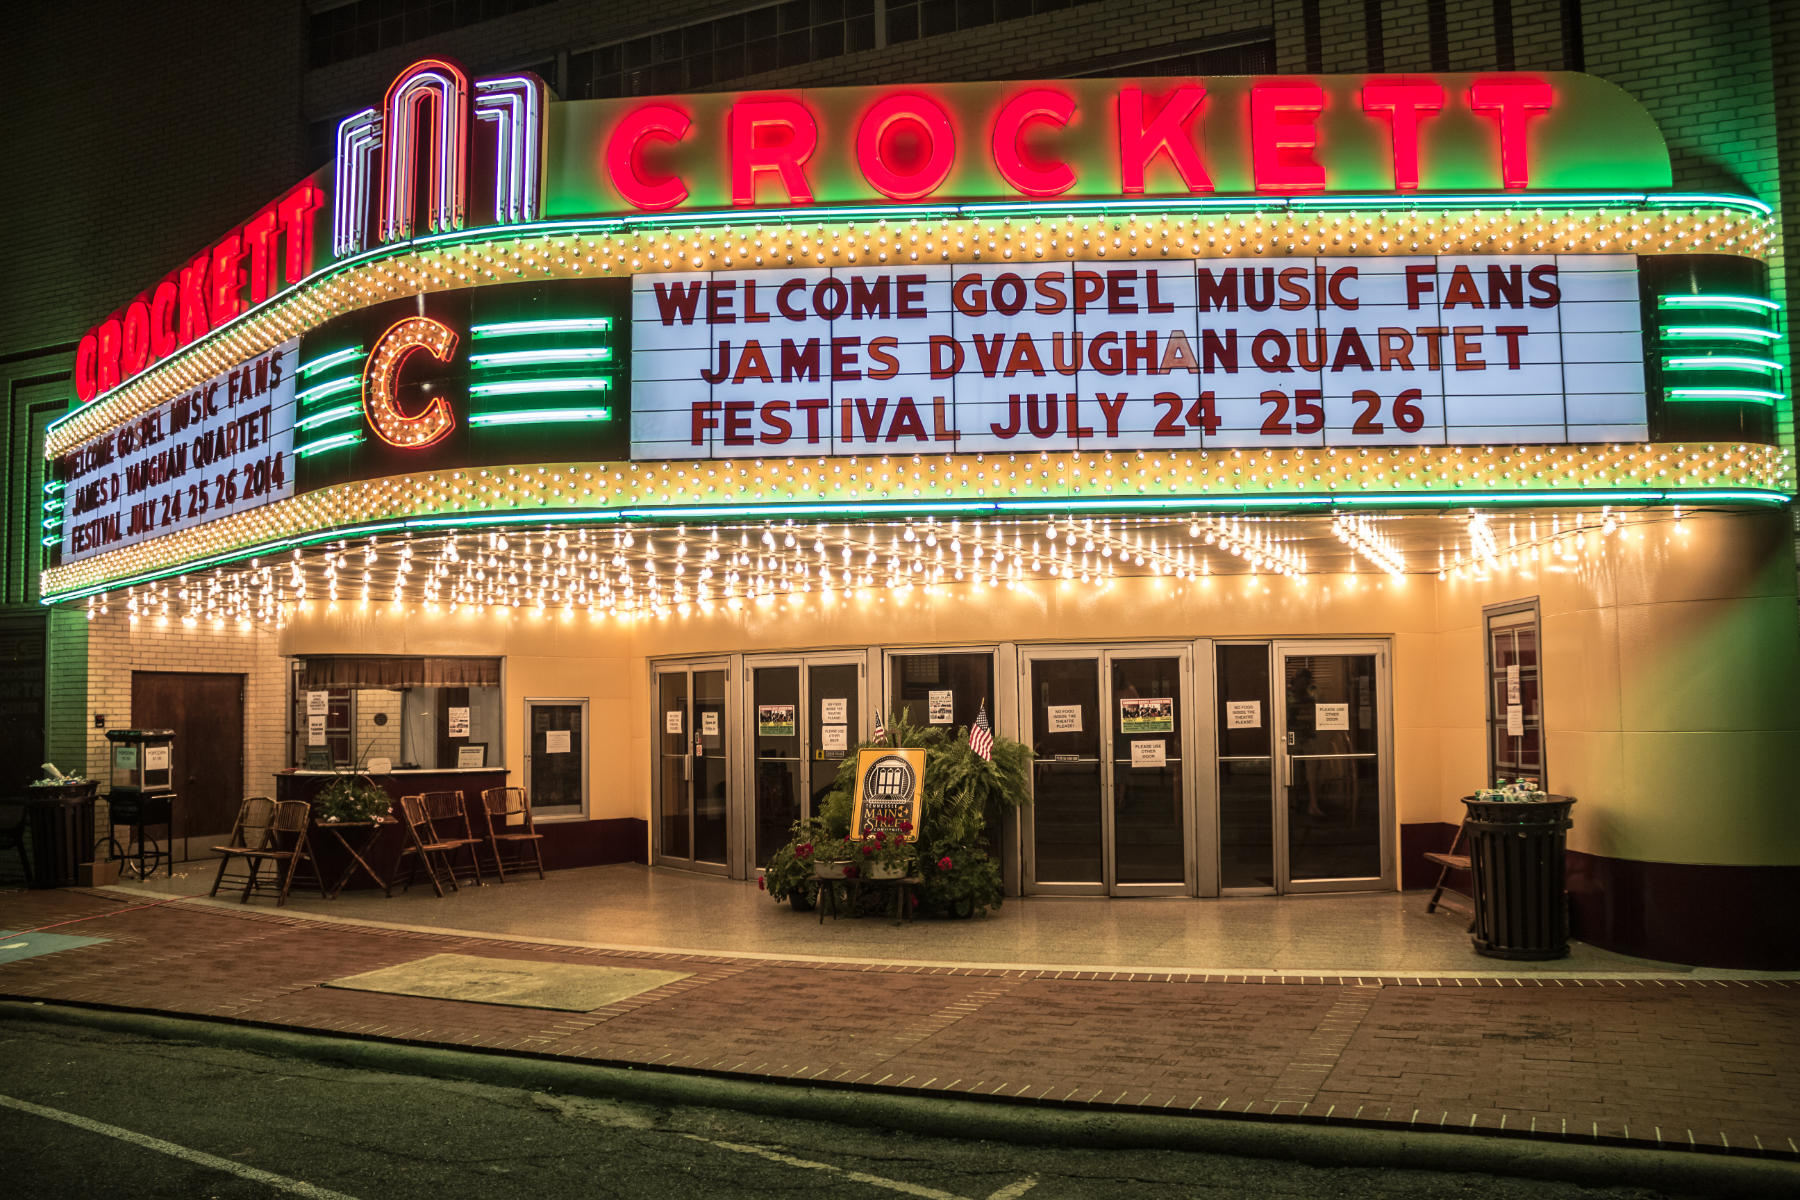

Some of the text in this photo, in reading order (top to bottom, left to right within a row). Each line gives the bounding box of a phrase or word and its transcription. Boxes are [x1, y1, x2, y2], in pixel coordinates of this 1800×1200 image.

[607, 84, 1553, 211] CROCKETT
[75, 186, 323, 403] CROCKETT
[653, 264, 1562, 326] WELCOME GOSPEL MUSIC FANS
[362, 316, 459, 449] C
[700, 335, 900, 384] JAMES
[1251, 325, 1528, 373] QUARTET
[64, 351, 283, 482] WELCOME GOSPEL MUSIC FANS
[72, 404, 271, 516] JAMES D VAUGHAN QUARTET
[691, 388, 1425, 446] FESTIVAL JULY 24 25 26
[71, 451, 285, 555] FESTIVAL JULY 24 25 26 2014
[864, 808, 898, 819] MAIN
